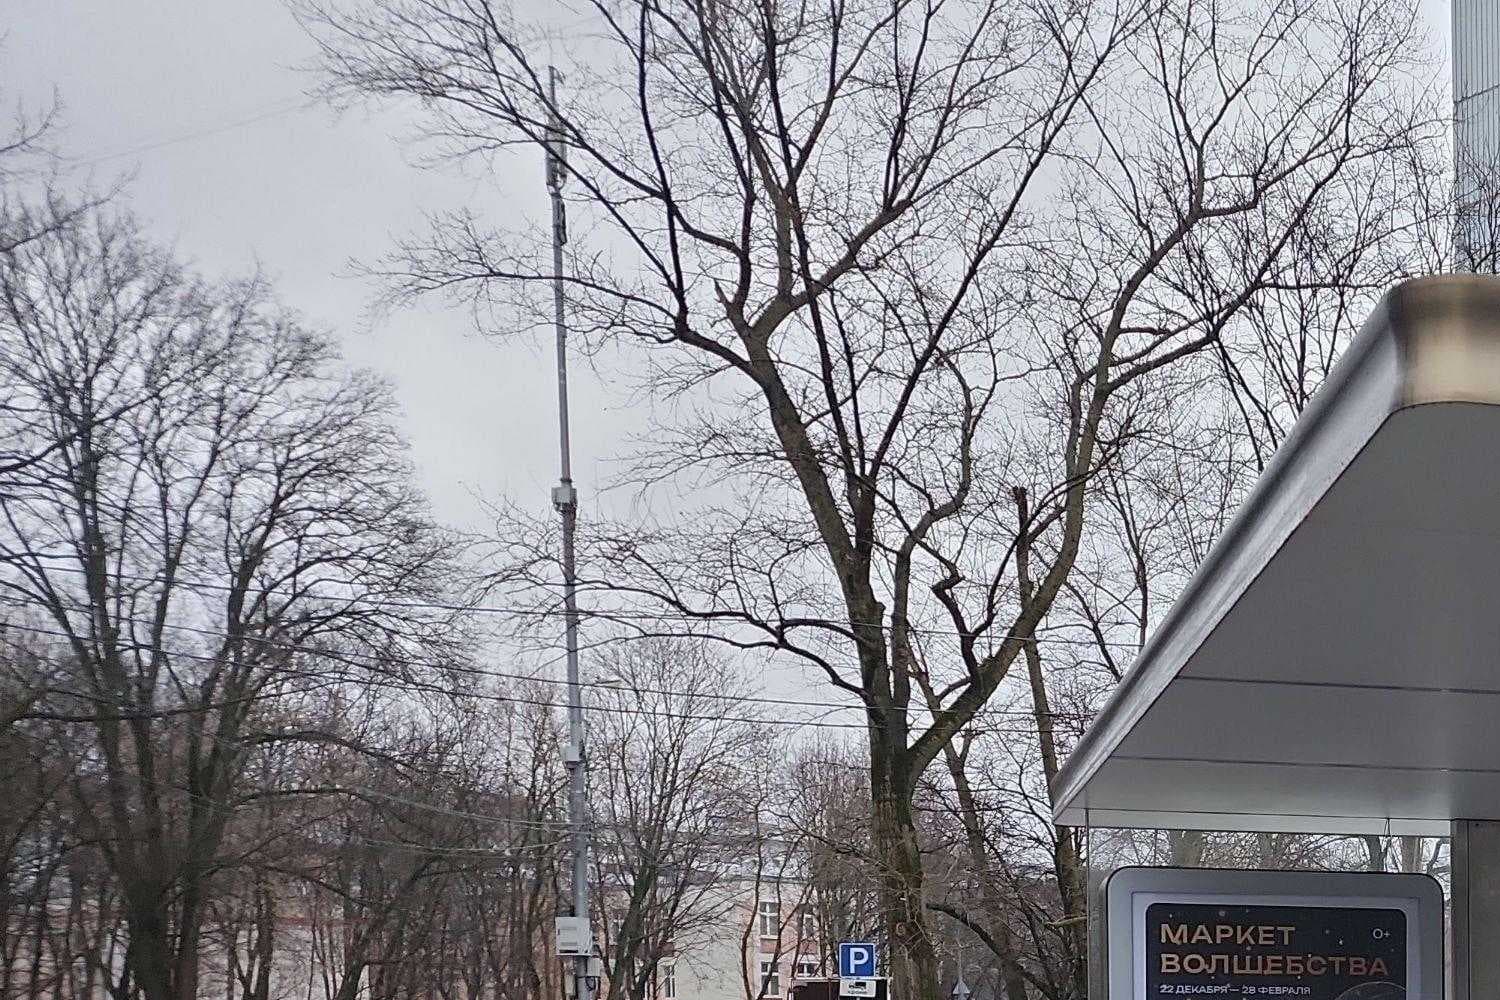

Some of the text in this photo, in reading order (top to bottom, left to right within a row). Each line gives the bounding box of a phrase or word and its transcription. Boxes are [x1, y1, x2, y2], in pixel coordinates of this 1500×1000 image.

[1160, 924, 1296, 945] МАРКЕТ
[849, 947, 869, 974] P
[1160, 953, 1389, 976] ВОЛШЕБСТВА
[1159, 985, 1174, 993] 22
[1175, 985, 1228, 994] ДЕКАБРЯ
[1241, 986, 1256, 994] 28
[1258, 986, 1311, 995] ФЕВРАЛЯ
